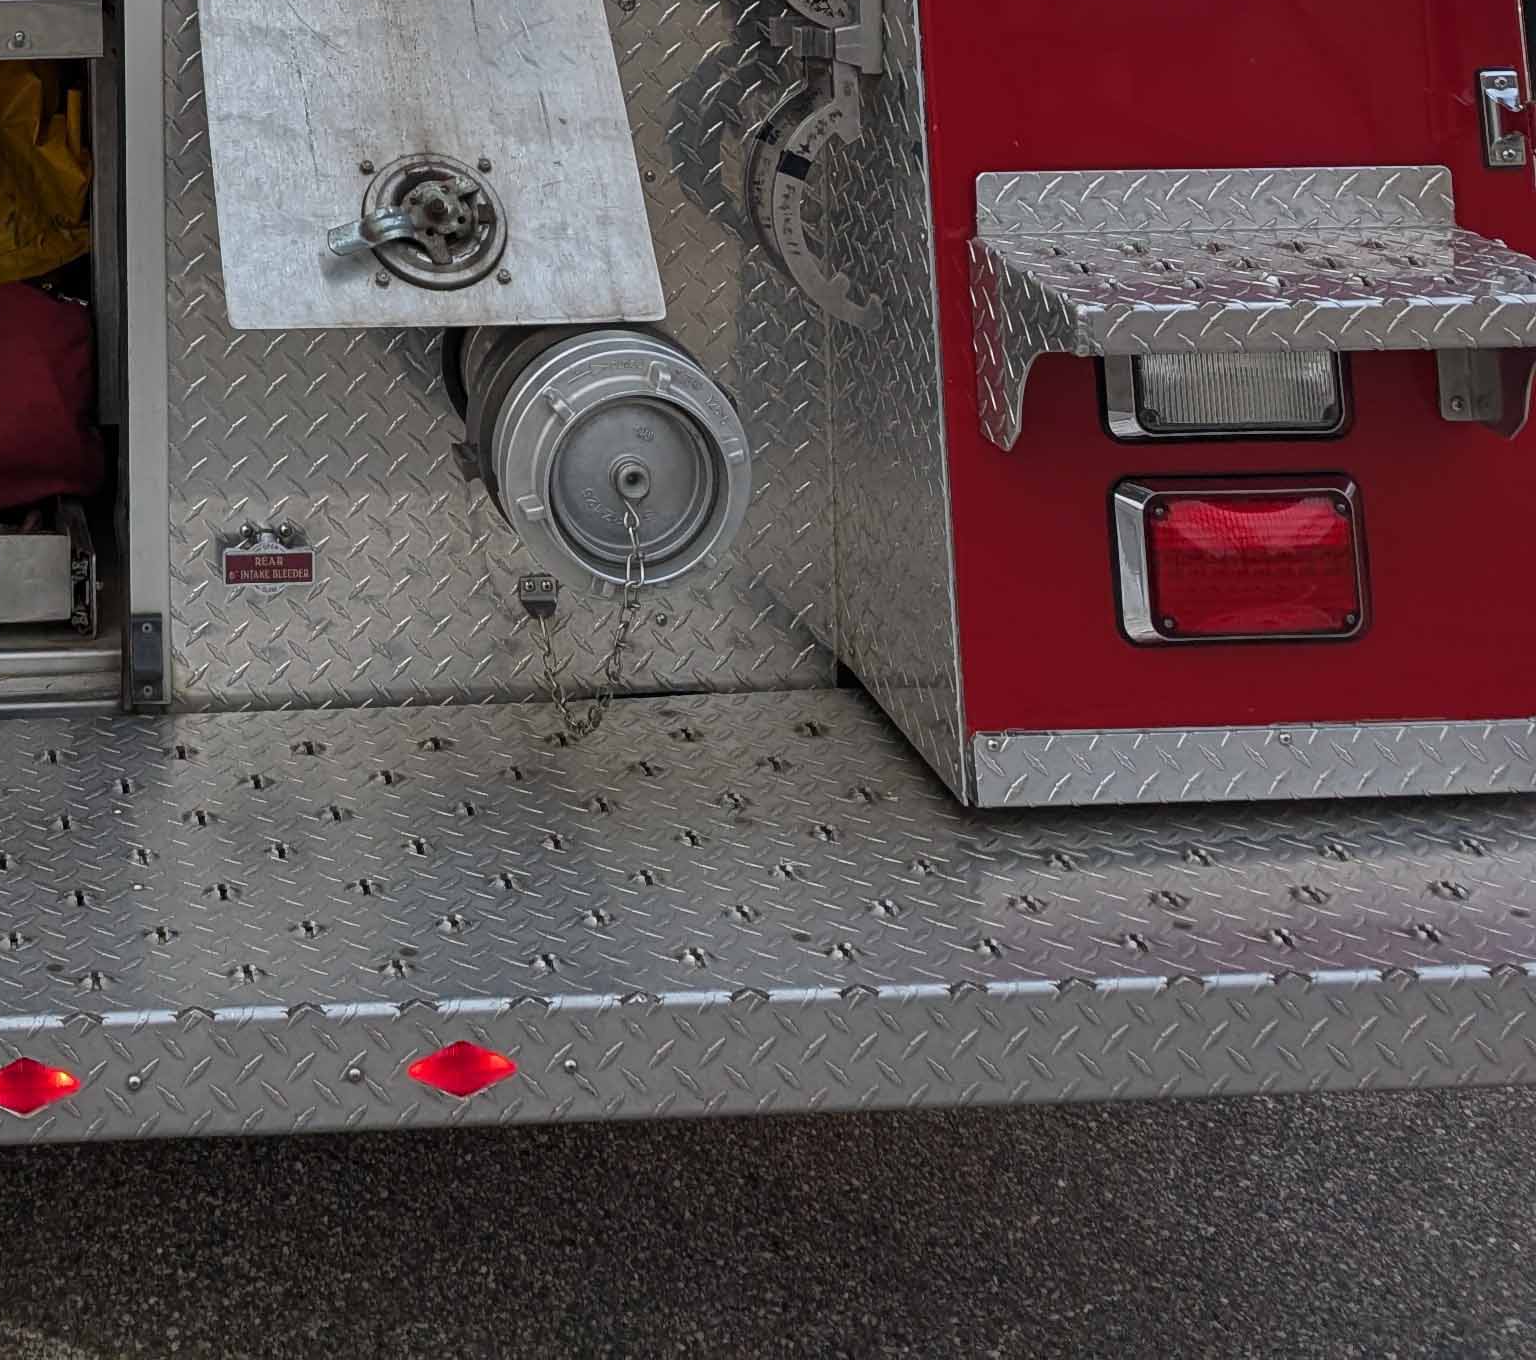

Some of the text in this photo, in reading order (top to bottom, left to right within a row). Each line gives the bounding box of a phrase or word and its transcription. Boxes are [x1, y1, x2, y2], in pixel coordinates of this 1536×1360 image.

[255, 556, 283, 566] REAR
[240, 569, 269, 580] INTAKE
[272, 568, 311, 579] BLEEDER
